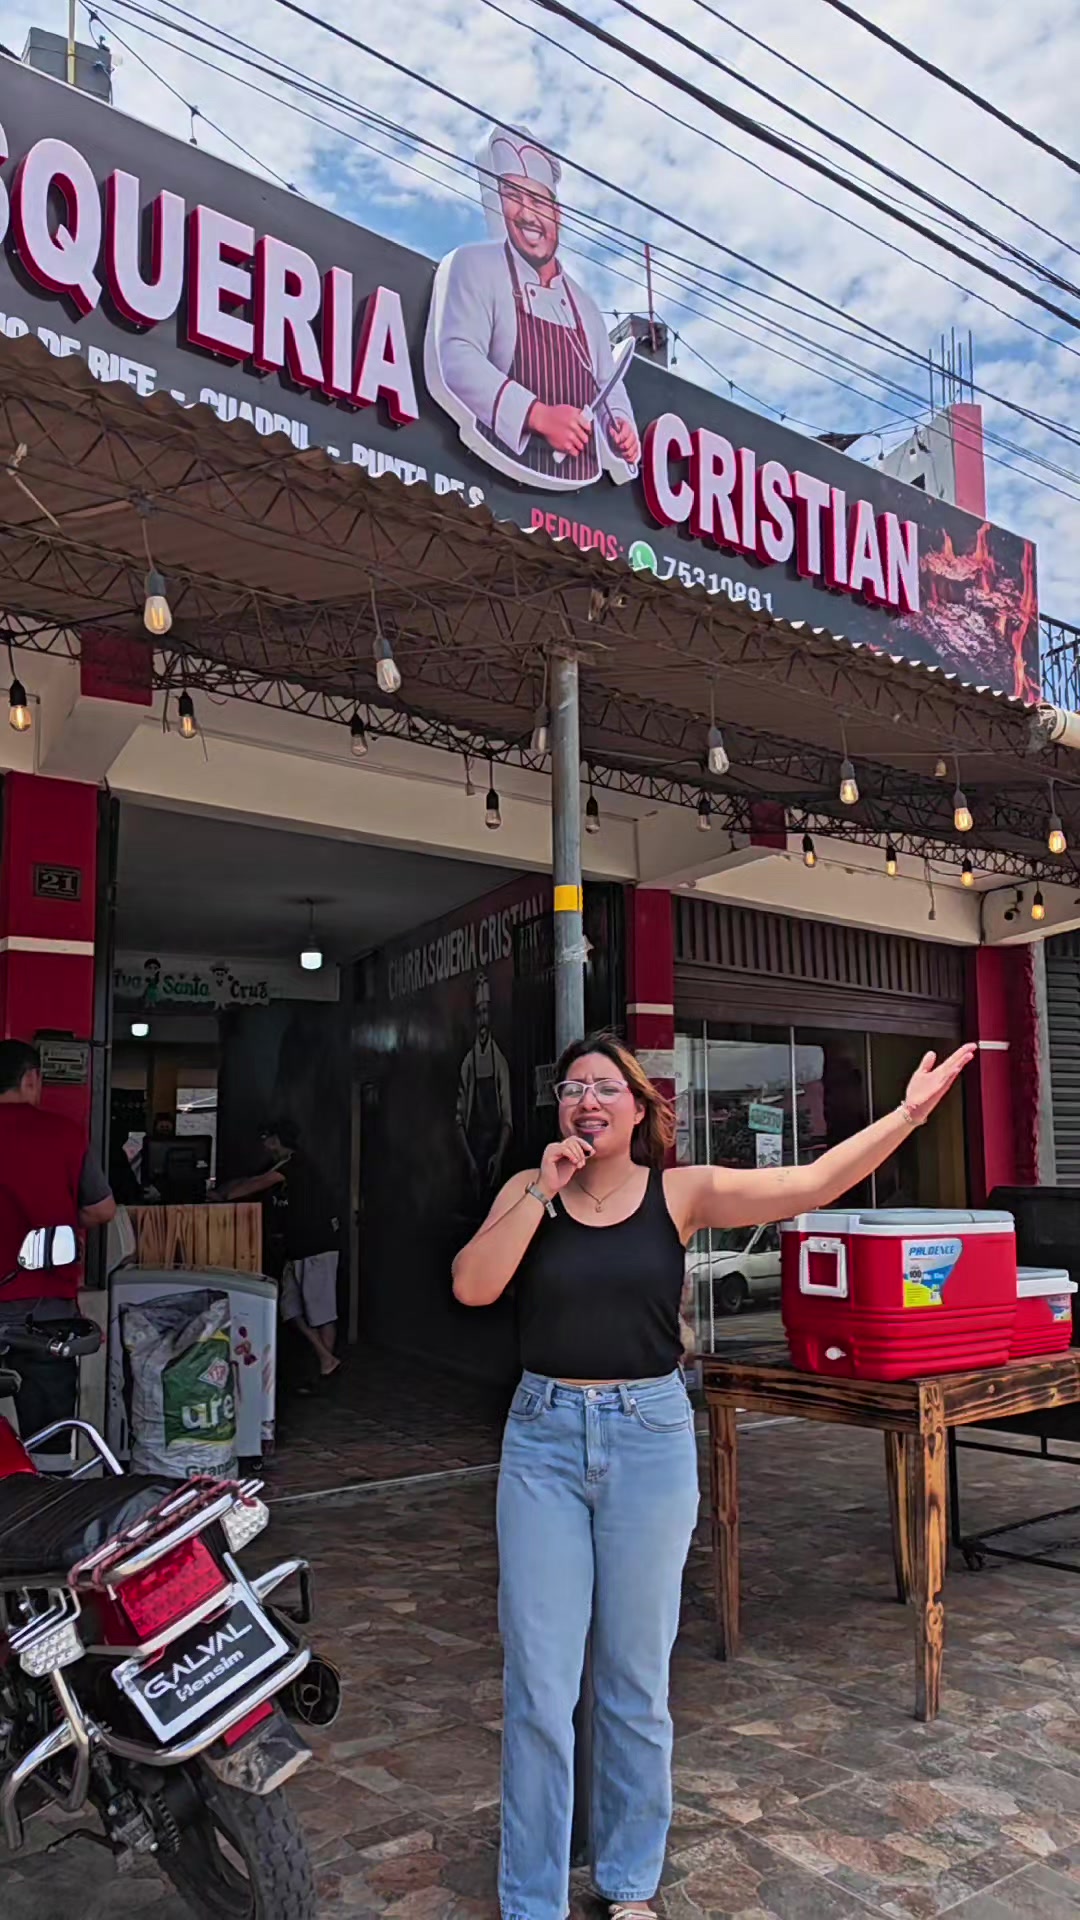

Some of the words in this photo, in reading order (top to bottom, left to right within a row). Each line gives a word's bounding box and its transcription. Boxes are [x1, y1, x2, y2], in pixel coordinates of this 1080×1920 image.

[0, 122, 420, 424] QUERIA
[643, 413, 921, 613] CRISTIAN
[42, 873, 75, 892] 21
[162, 973, 210, 997] Santa
[388, 922, 477, 1000] CHURRASQUERIA
[144, 1623, 252, 1698] GALVAL
